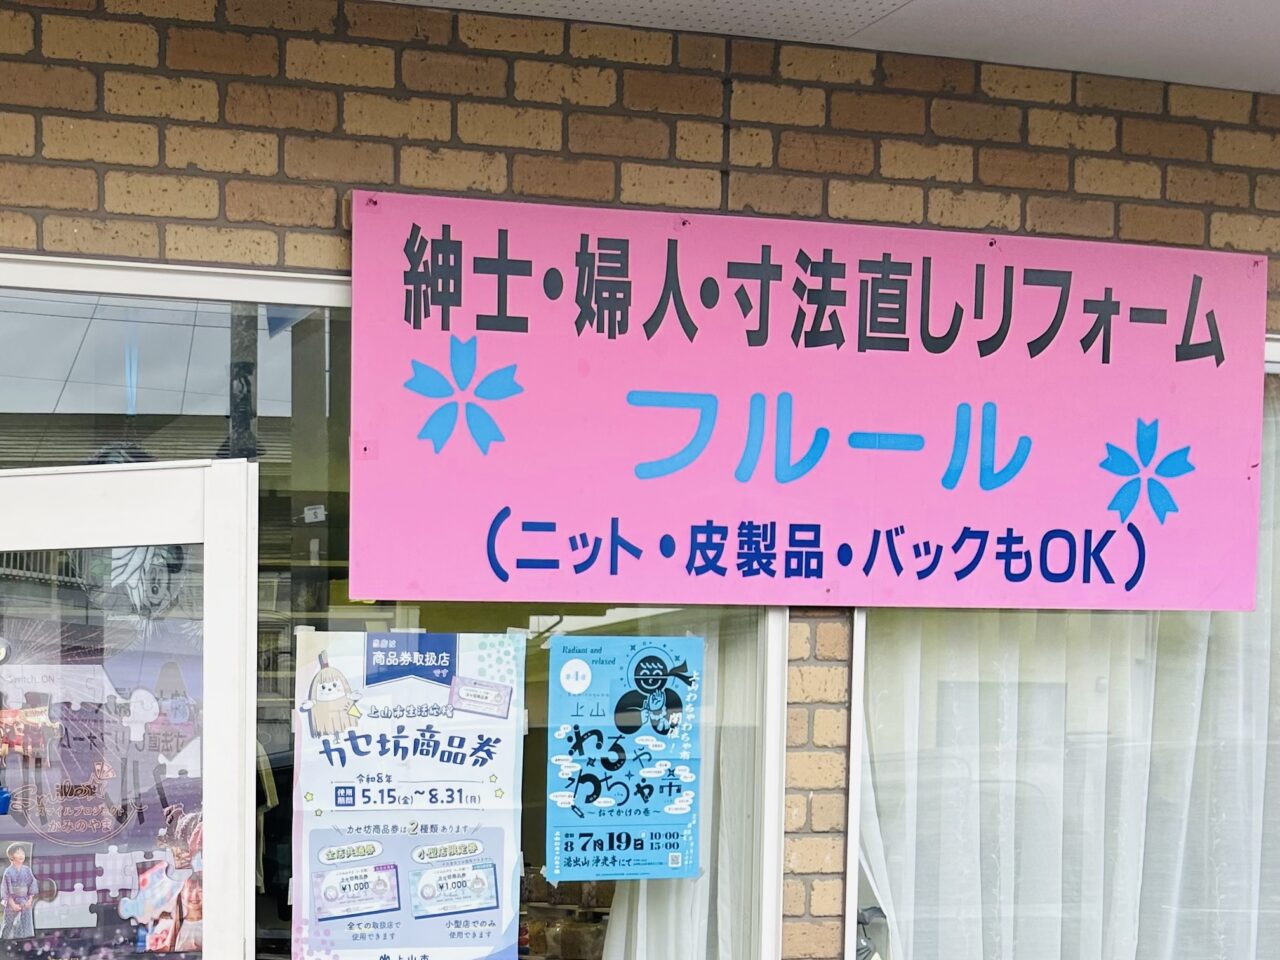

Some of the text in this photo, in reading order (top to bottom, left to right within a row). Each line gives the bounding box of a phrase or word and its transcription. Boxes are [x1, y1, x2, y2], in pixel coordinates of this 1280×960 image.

[403, 223, 1226, 368] 紳士・婦人・寸法直しリフォーム
[626, 390, 1033, 492] フルール
[372, 651, 451, 667] 商品券取扱店
[592, 657, 616, 665] relaxed
[319, 723, 502, 768] カセ坊商品券
[356, 773, 393, 784] 令和8年
[47, 818, 113, 834] かみのやま
[650, 841, 680, 850] 15:00
[445, 920, 496, 929] 小型店でのみ
[351, 932, 396, 941] 使用できます
[449, 931, 492, 940] 使用できます
